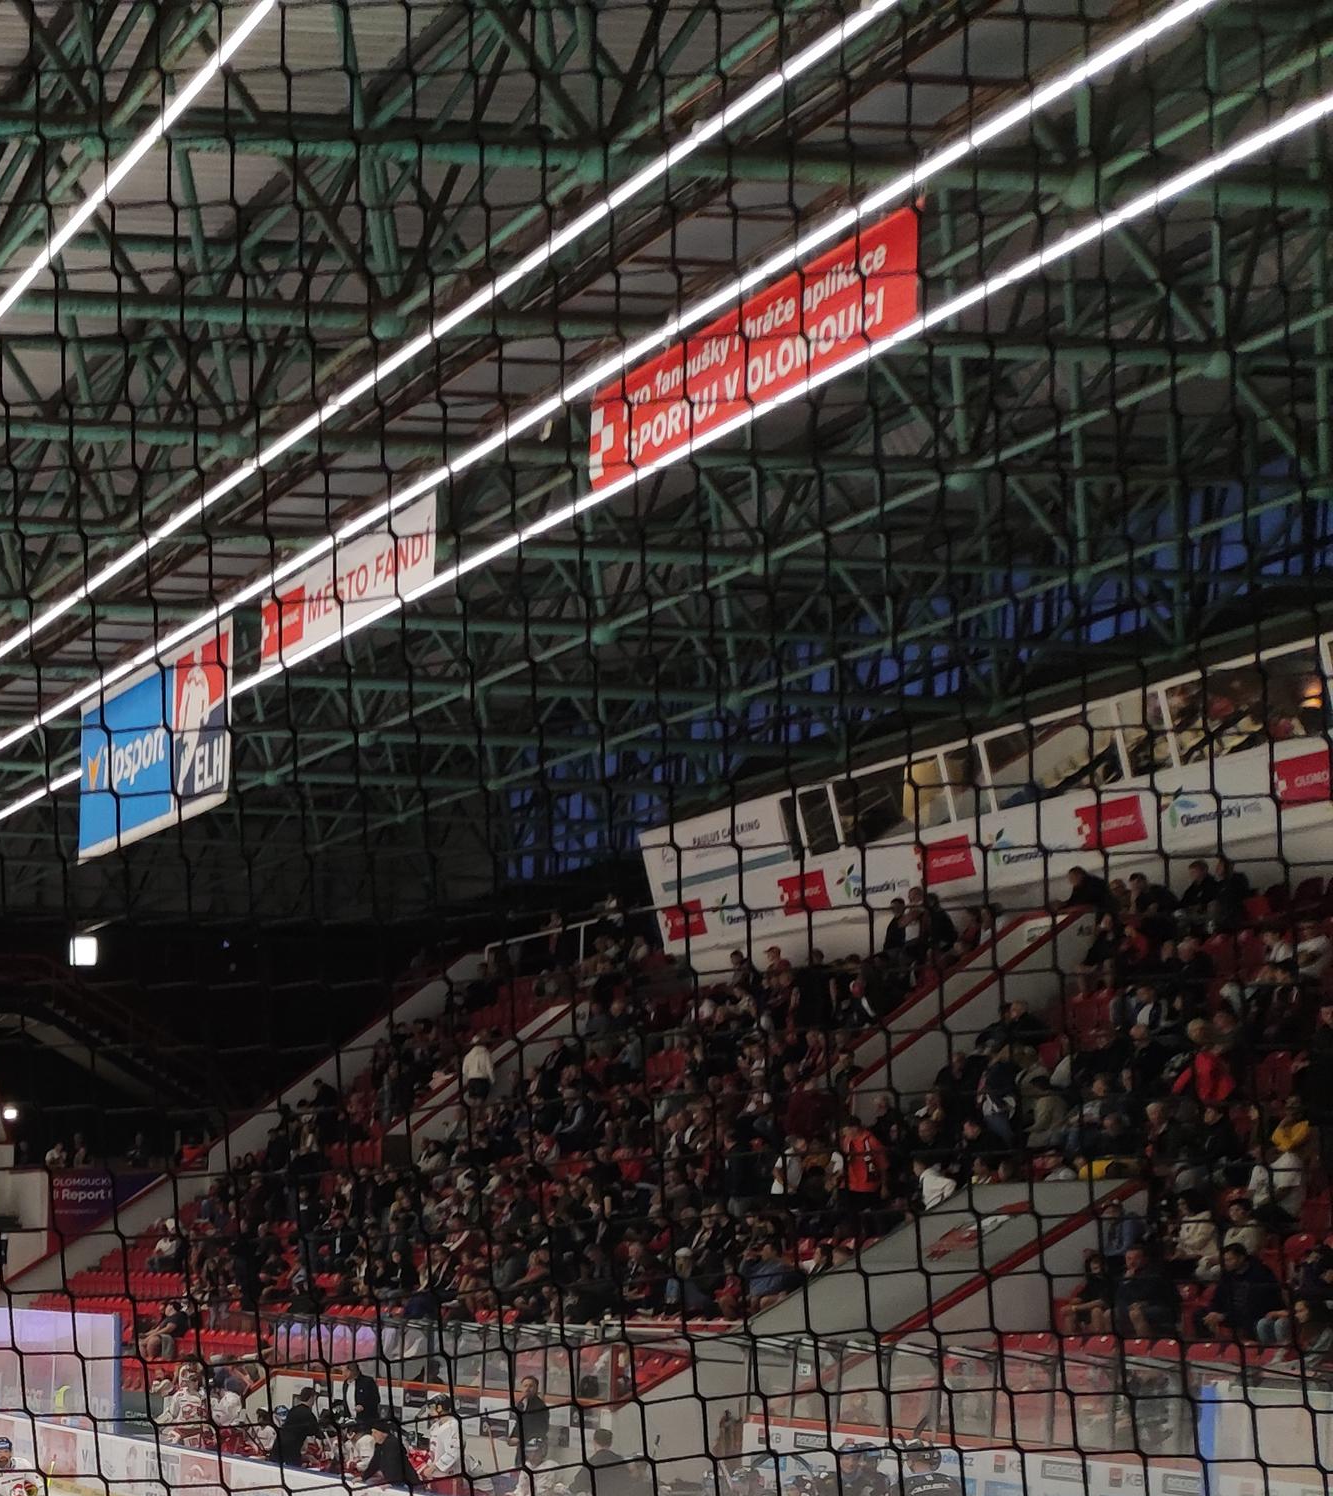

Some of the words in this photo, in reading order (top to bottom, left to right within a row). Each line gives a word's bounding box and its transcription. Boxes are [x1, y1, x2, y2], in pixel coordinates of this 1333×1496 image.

[655, 337, 730, 395] fanoušky
[745, 297, 796, 341] hráče
[803, 244, 888, 313] aplikace
[624, 384, 718, 460] SPORTUJ
[724, 368, 741, 407] V
[747, 287, 885, 395] OLOMOUCI
[307, 563, 369, 625] MĚSTO
[374, 514, 432, 588] FANDÍ
[194, 733, 225, 795] ELH
[1294, 770, 1331, 788] OLOMO
[61, 1188, 106, 1203] Report
